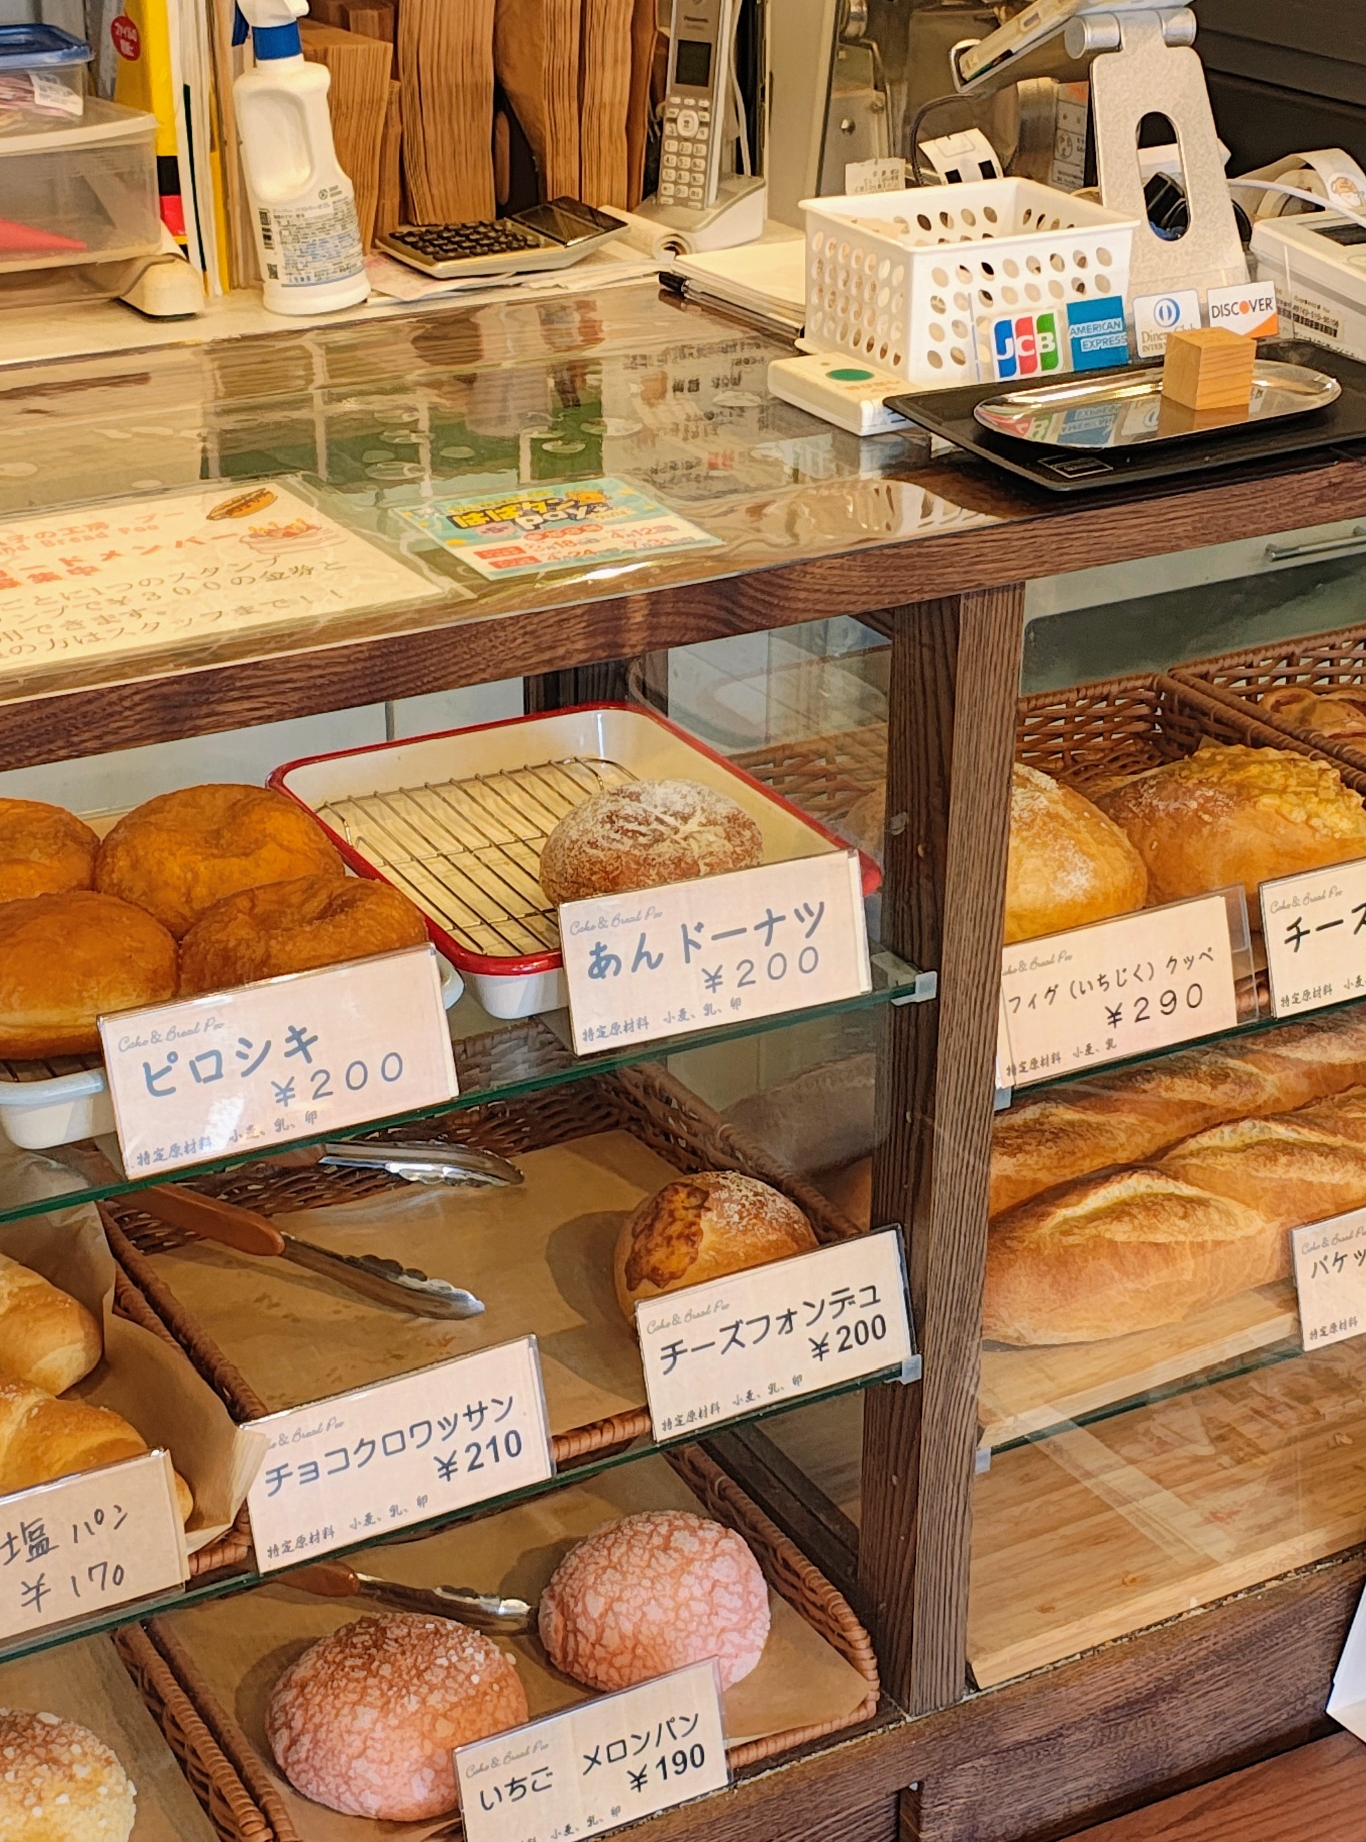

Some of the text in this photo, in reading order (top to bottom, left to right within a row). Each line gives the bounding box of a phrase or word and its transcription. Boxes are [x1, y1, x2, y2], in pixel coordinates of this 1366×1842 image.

[1069, 320, 1122, 337] AMERICAN
[1211, 296, 1274, 319] DISCOVER
[996, 331, 1056, 360] JCB
[1082, 334, 1128, 351] EXPRESS
[39, 532, 110, 549] Bread
[587, 900, 825, 981] あんドーナツ
[701, 946, 820, 995] ¥200
[581, 996, 743, 1043] 特定原材料 小麦、乳、卵
[1104, 982, 1203, 1030] ¥290
[1280, 983, 1334, 1008] 特定原材料
[142, 1023, 319, 1098] ピロシキ
[270, 1051, 404, 1108] ¥200
[136, 1136, 214, 1168] 特定原材料
[660, 1283, 882, 1376] チーズフォンデュ
[807, 1313, 887, 1363] ¥200
[661, 1401, 721, 1433] 特定原材料
[265, 1395, 514, 1498] チョコクロワッサン
[433, 1428, 523, 1483] ¥210
[266, 1524, 336, 1560] 特定原材料
[20, 1560, 125, 1614] ¥170
[479, 1712, 700, 1812] いちご メロンパン
[626, 1742, 706, 1793] ¥190
